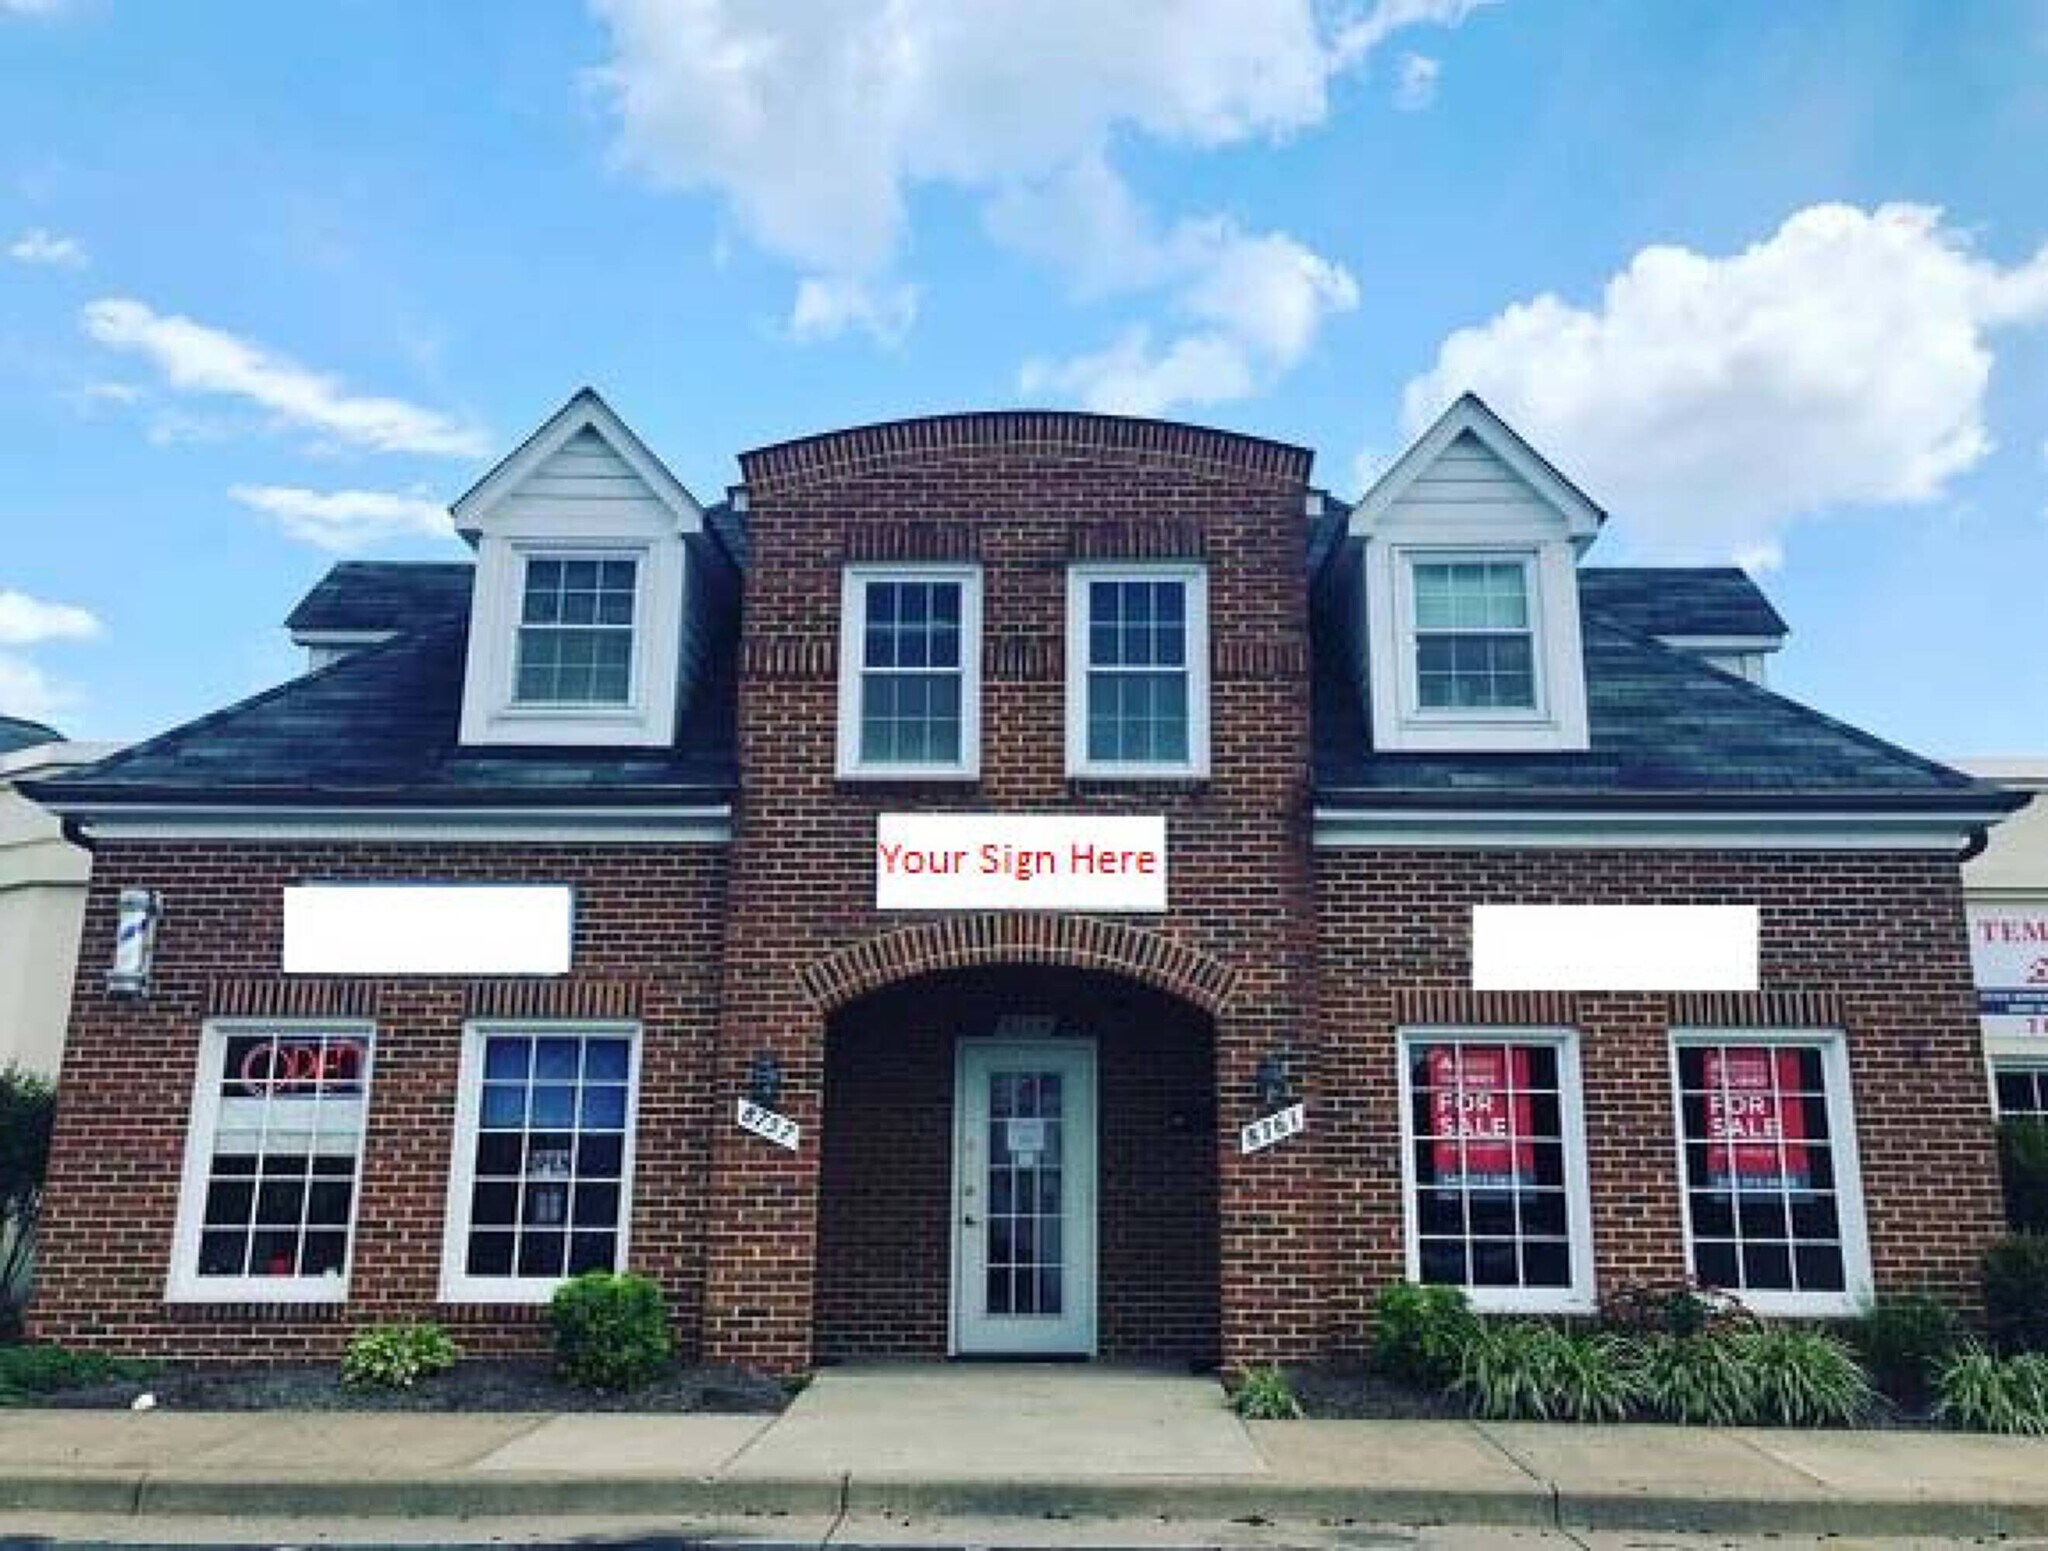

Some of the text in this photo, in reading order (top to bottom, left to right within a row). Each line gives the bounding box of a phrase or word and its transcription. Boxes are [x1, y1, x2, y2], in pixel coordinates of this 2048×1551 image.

[1437, 1093, 1494, 1112] FOR
[1710, 1096, 1766, 1115] FOR
[1437, 1117, 1507, 1137] SALE
[1710, 1117, 1781, 1137] SALE
